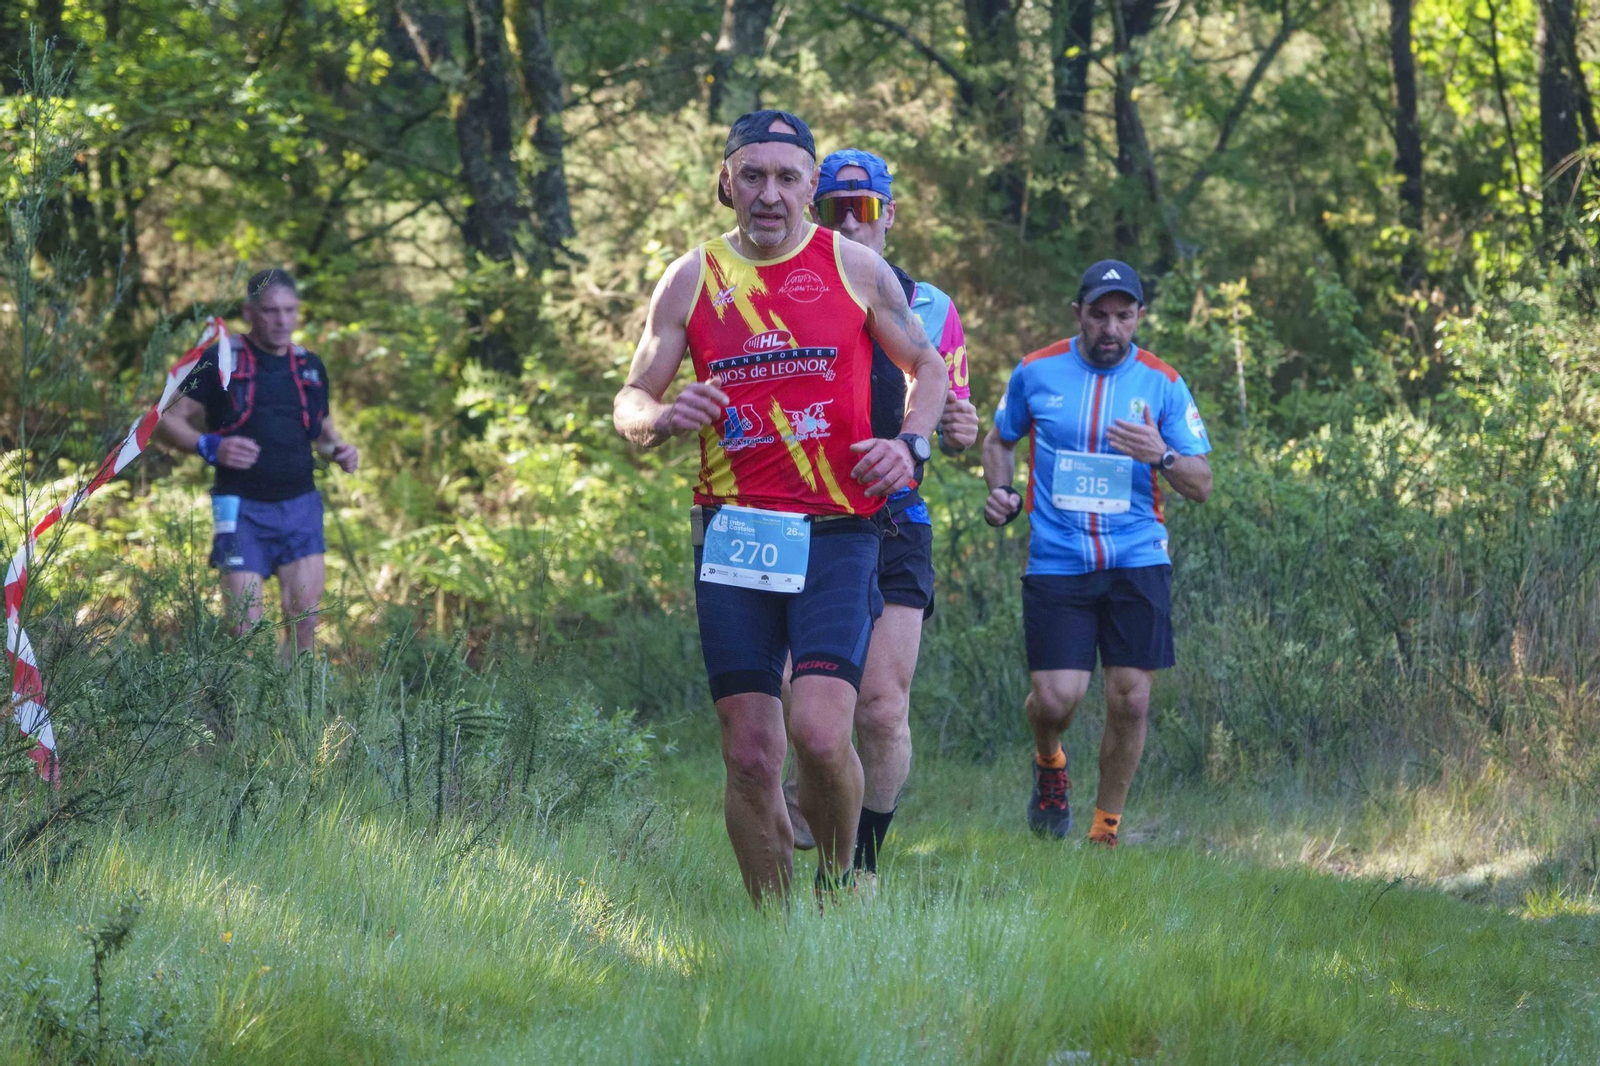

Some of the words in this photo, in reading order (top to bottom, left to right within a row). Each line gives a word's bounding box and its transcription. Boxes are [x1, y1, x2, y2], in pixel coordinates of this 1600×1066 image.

[760, 333, 786, 349] HL
[710, 349, 836, 370] TRANSPORTES
[750, 365, 767, 378] de
[771, 359, 828, 376] LEONOR
[1075, 476, 1109, 495] 315
[729, 525, 755, 533] Castelos
[786, 527, 798, 536] 26
[729, 539, 778, 567] 270
